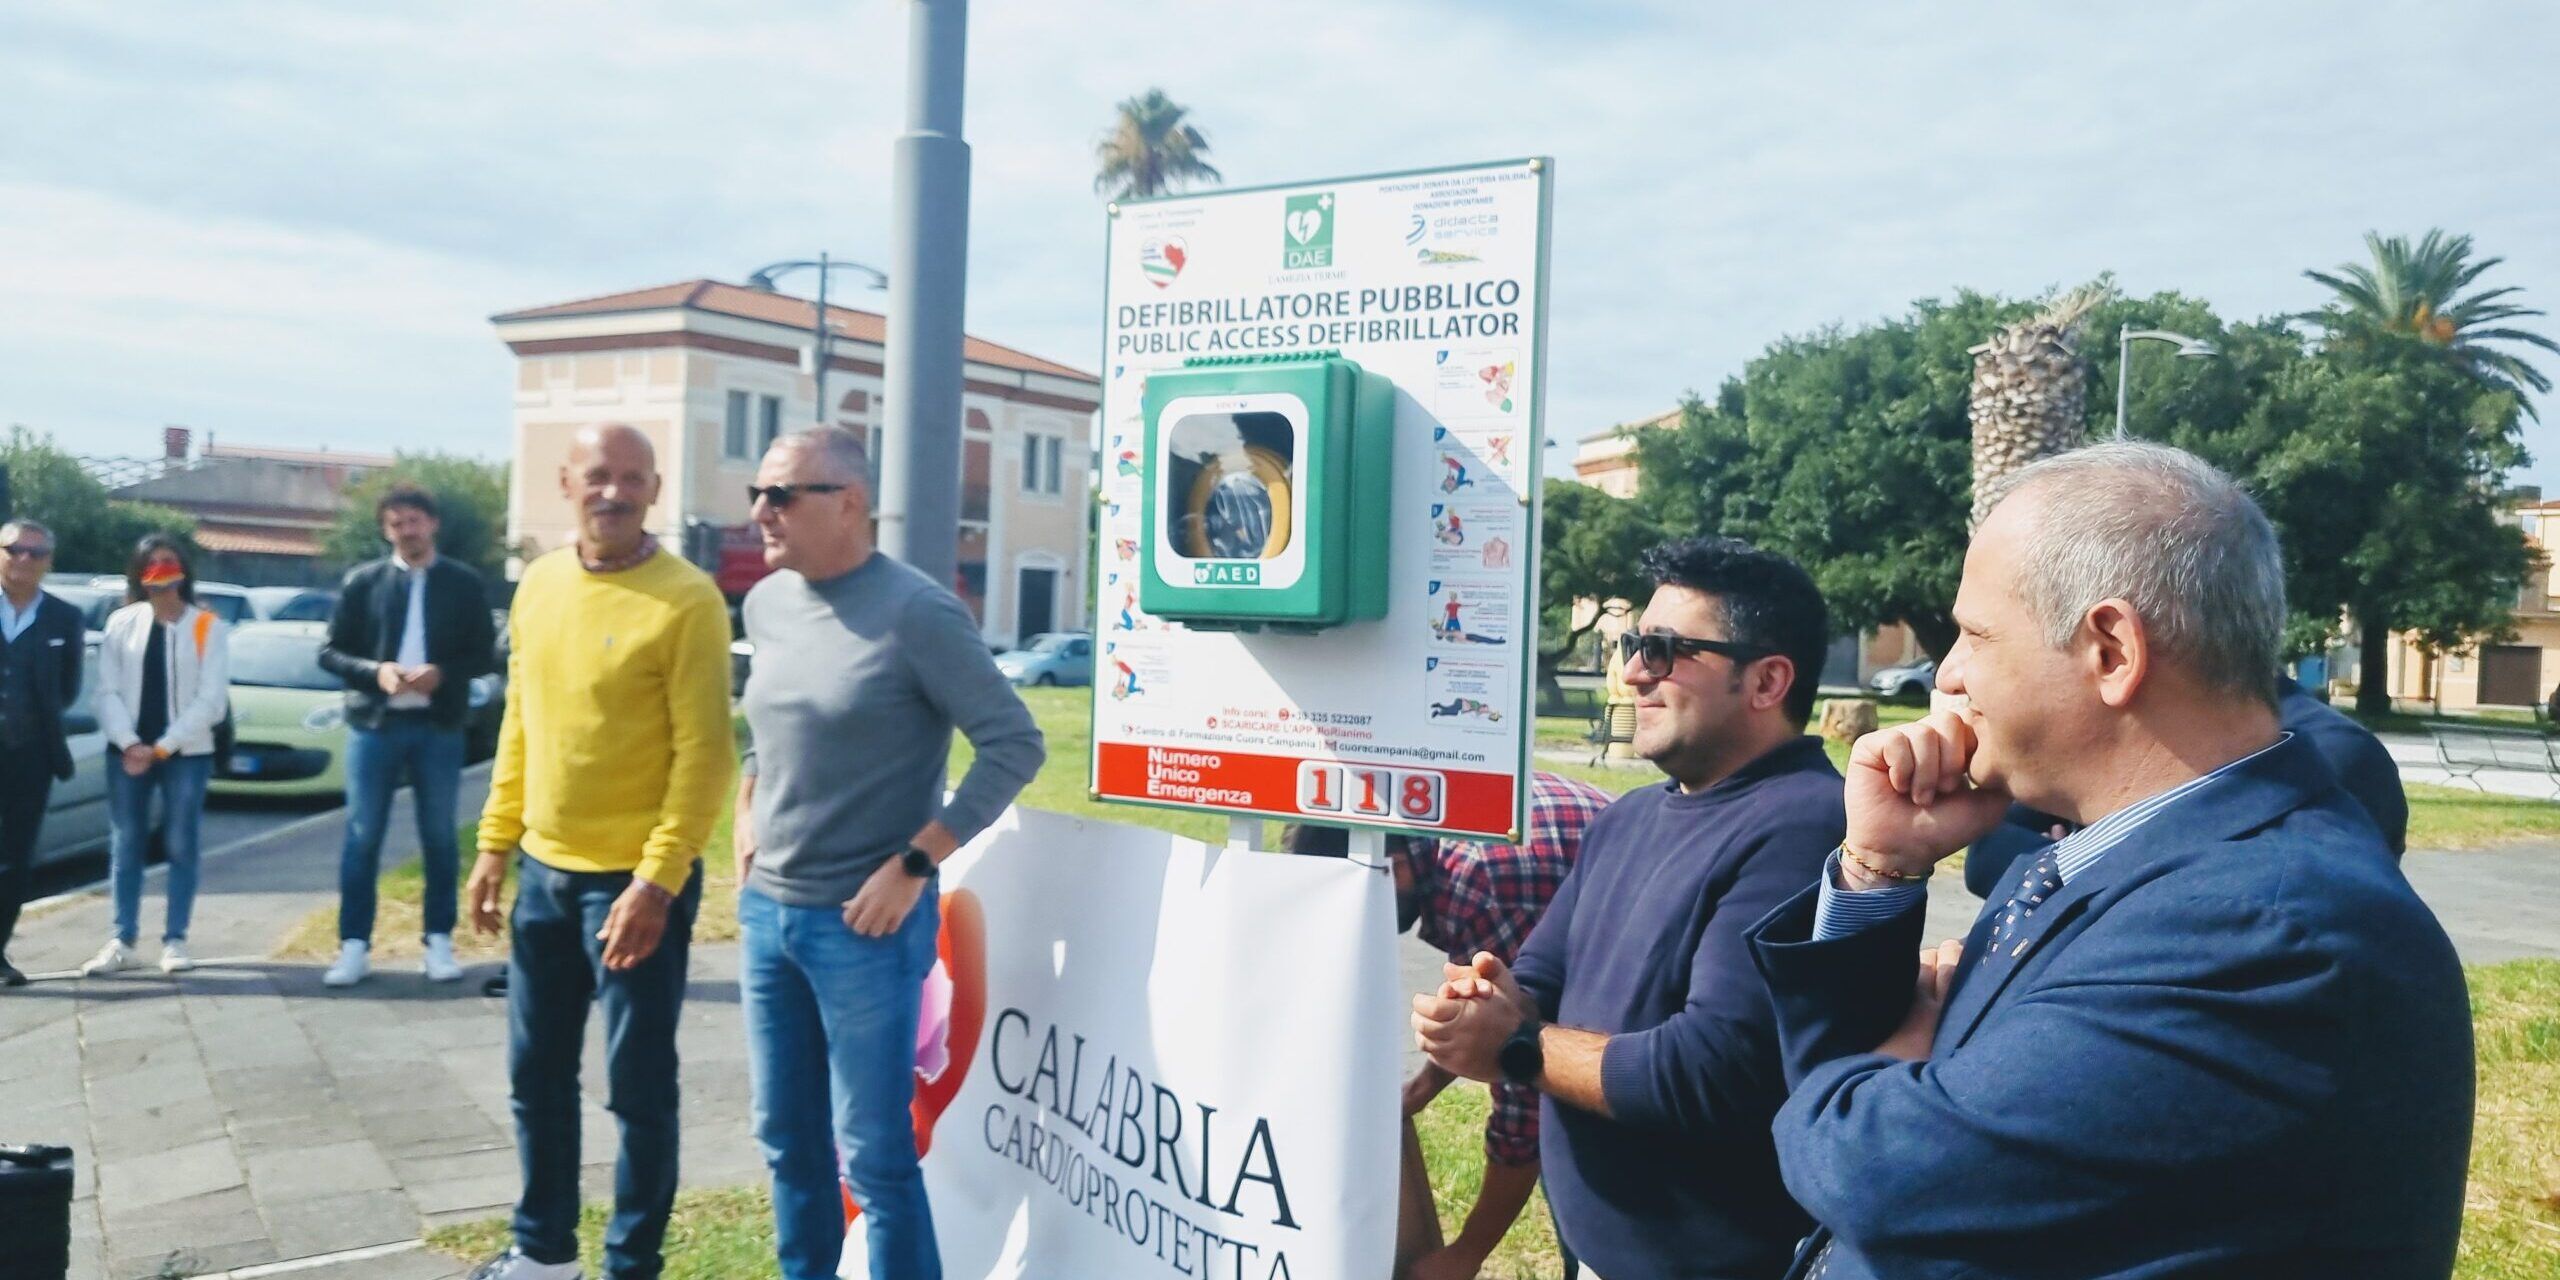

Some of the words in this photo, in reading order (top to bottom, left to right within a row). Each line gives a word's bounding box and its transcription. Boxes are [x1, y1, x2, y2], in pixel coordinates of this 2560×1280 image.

[1434, 214, 1498, 228] didacta
[1288, 251, 1326, 266] DAE
[1118, 291, 1350, 329] DEFIBRILLATORE
[1360, 279, 1520, 315] PUBBLICO
[1118, 330, 1200, 355] PUBLIC
[1207, 325, 1300, 350] ACCESS
[1308, 312, 1519, 345] DEFIBRILLATOR
[1216, 566, 1258, 581] AED
[1221, 719, 1280, 732] SCARICARE
[1283, 723, 1313, 734] L'APP
[1222, 706, 1242, 717] Info
[1330, 714, 1372, 725] 5232087
[1135, 726, 1165, 737] Centro
[1168, 728, 1176, 738] di
[1179, 730, 1233, 742] Formazione
[1236, 734, 1264, 745] Cuore
[1267, 736, 1316, 749] Campania
[1338, 744, 1486, 763] cuorecampania@gmail.com
[1147, 747, 1221, 770] Numero
[1147, 765, 1200, 783] Unico
[1147, 779, 1252, 805] Emergenza
[1311, 767, 1432, 815] 118
[991, 1007, 1302, 1230] CALABRIA
